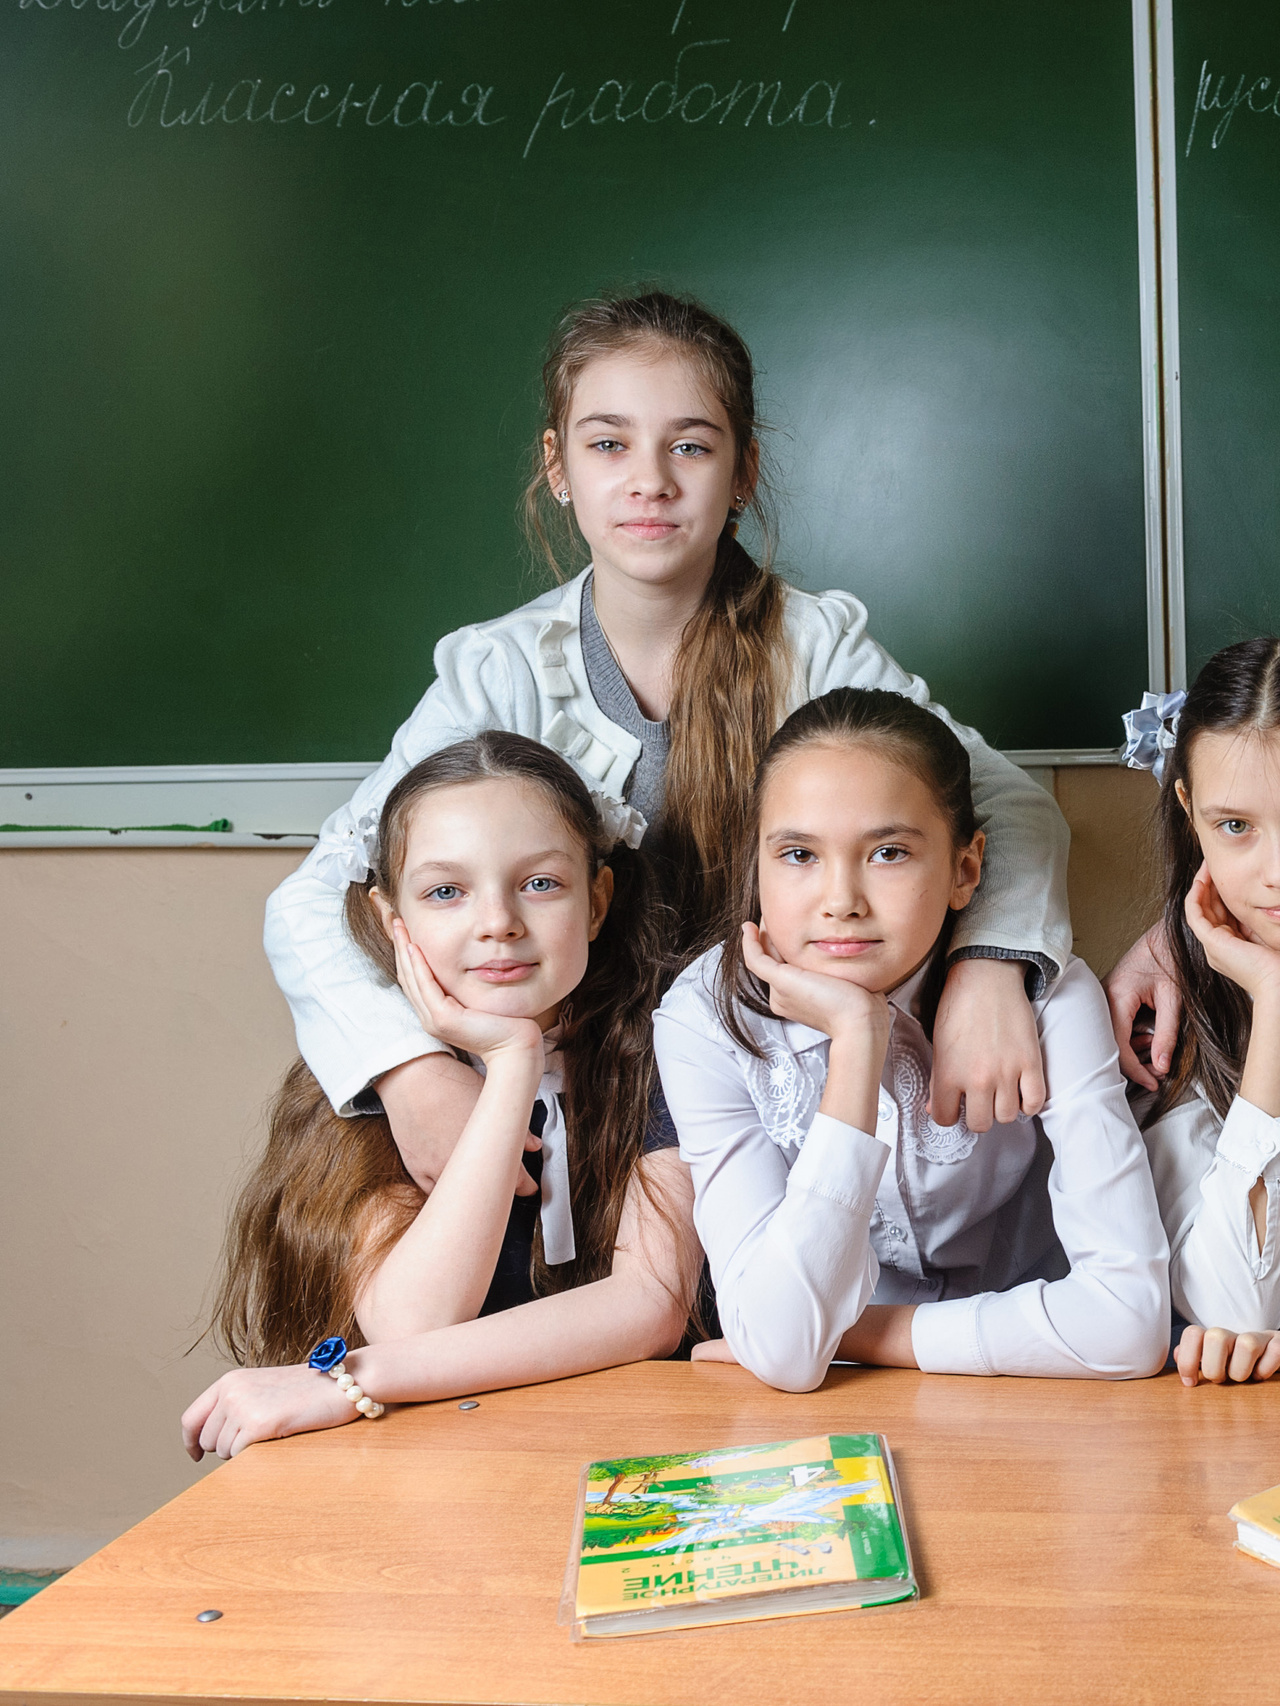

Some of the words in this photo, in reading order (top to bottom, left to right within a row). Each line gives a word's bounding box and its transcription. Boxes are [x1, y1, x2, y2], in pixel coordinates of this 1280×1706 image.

[127, 45, 506, 128] Классная
[787, 1465, 826, 1487] 4
[622, 1566, 826, 1600] ЛИТЕРАТУРНОЕ
[623, 1558, 799, 1591] ЧТЕНИЕ
